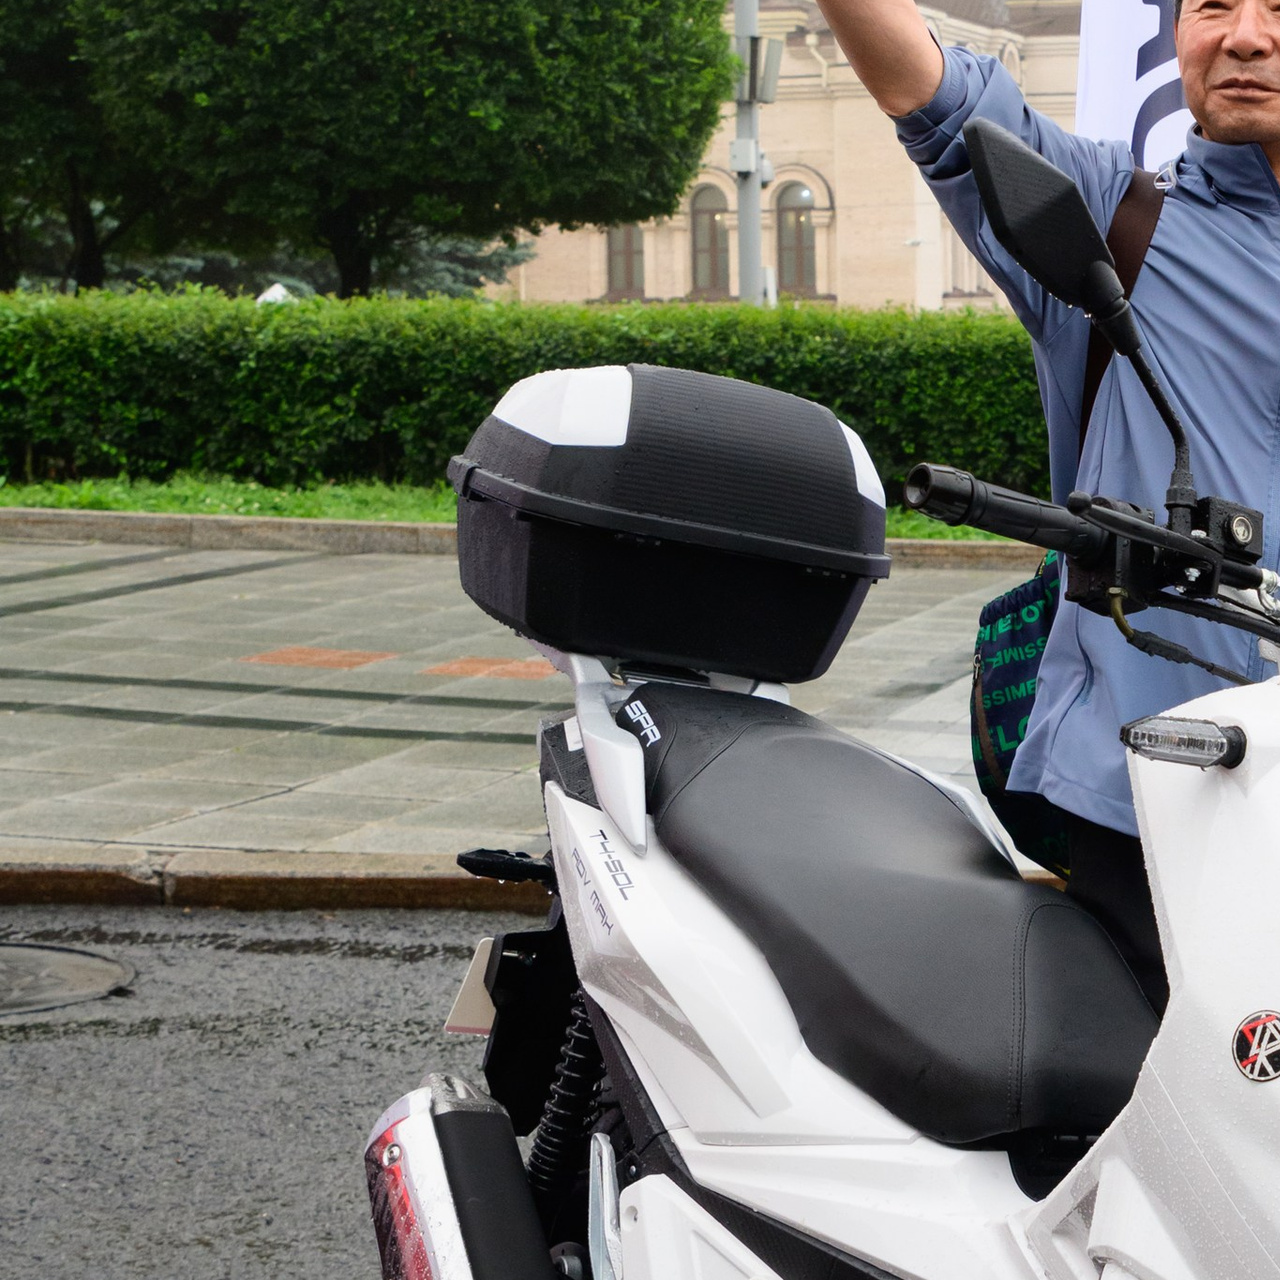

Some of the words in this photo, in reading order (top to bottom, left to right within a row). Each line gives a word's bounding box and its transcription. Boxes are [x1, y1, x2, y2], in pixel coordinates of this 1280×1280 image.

[625, 700, 661, 747] SPR
[571, 847, 592, 887] ADV
[589, 890, 615, 936] MAX
